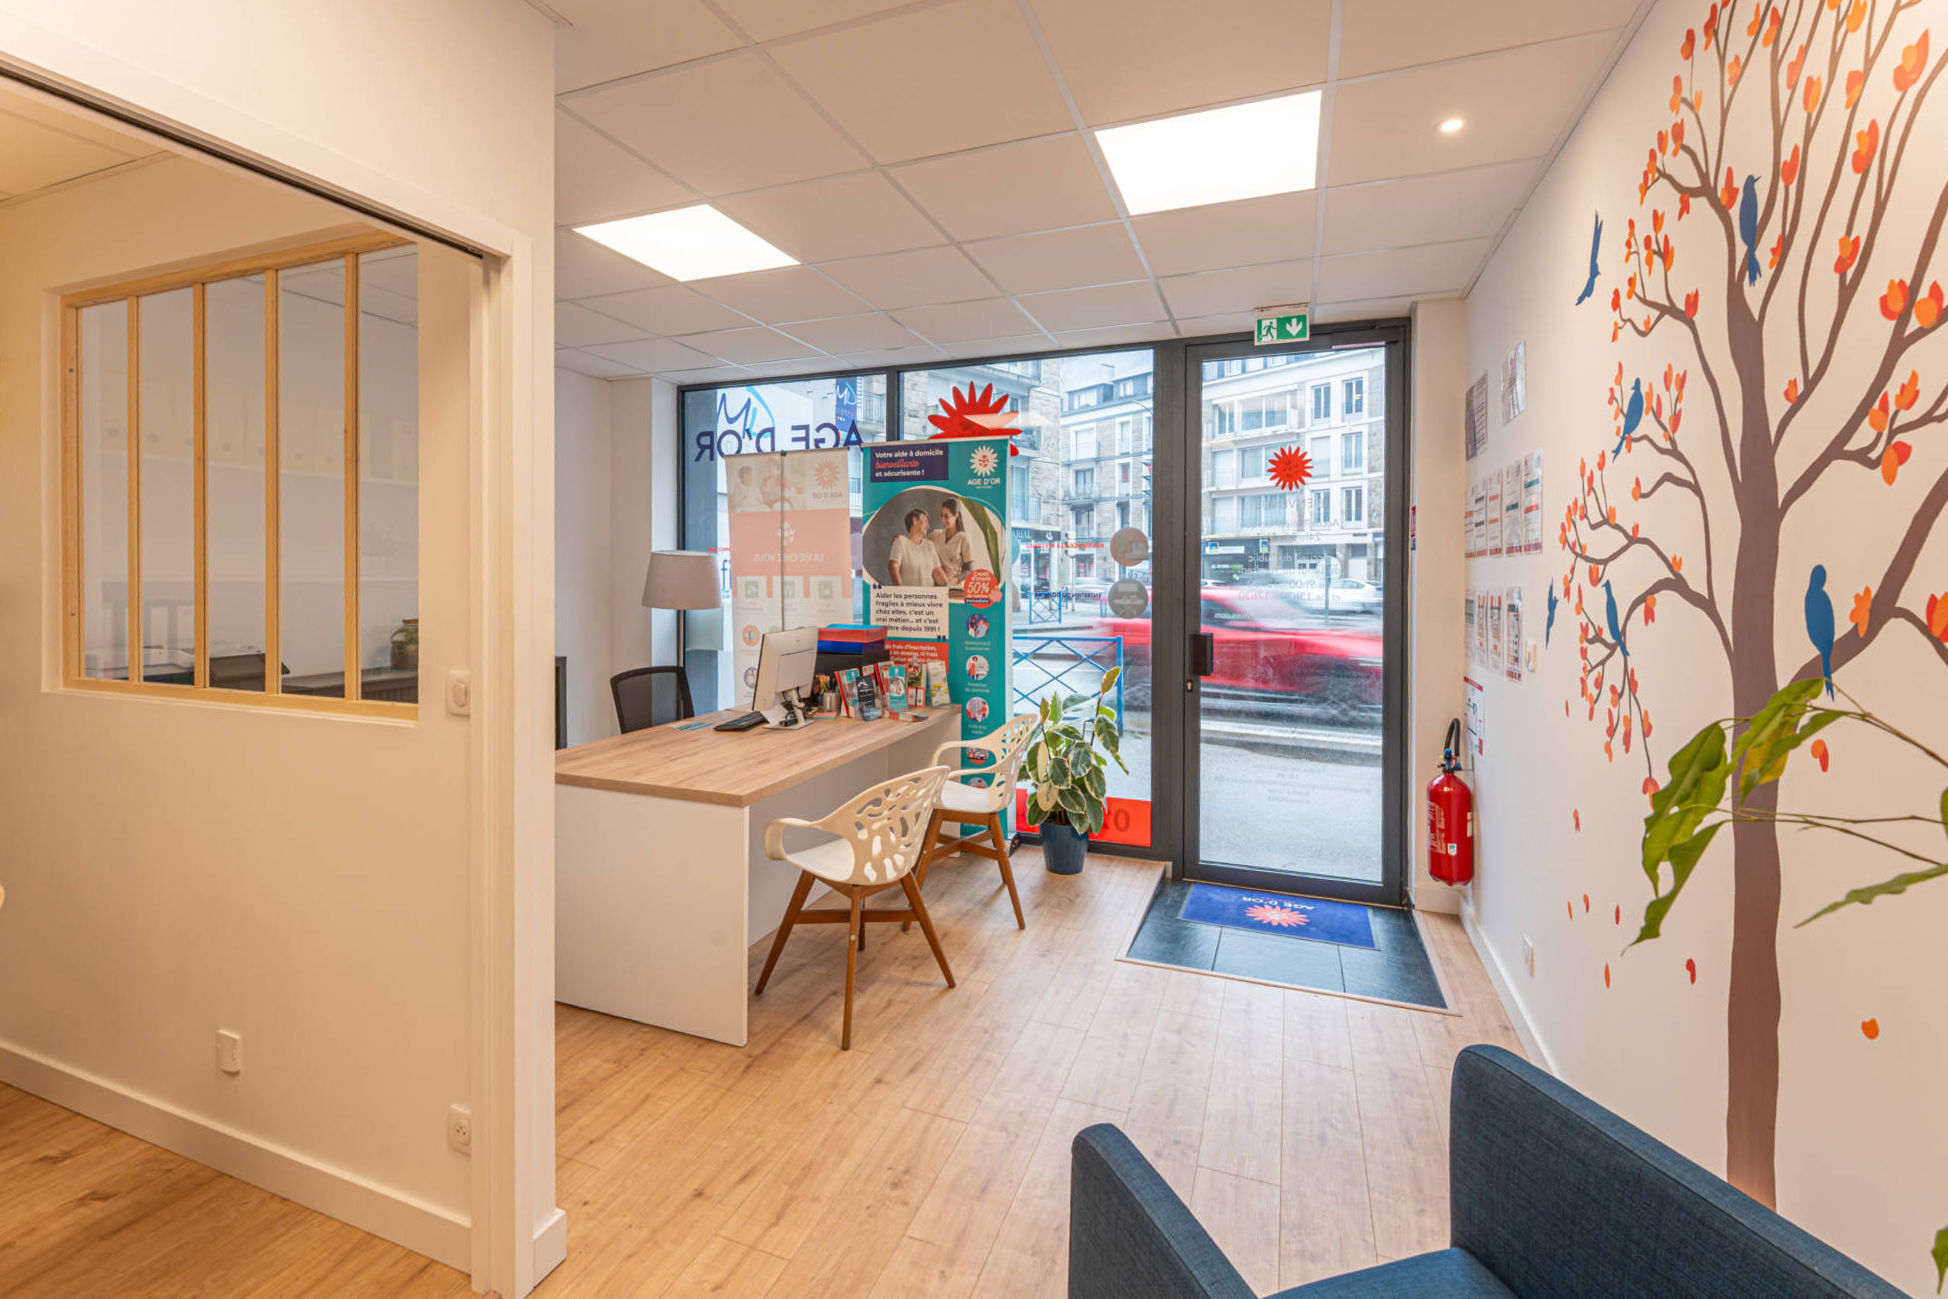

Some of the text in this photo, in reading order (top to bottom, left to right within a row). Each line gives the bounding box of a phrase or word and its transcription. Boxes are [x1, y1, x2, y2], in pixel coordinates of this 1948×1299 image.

[875, 451, 893, 459] Votre
[909, 448, 914, 457] à
[915, 448, 944, 457] domicile
[884, 469, 921, 478] sécurisante
[967, 477, 1000, 486] AGE D'OR
[967, 582, 990, 594] 50%
[901, 625, 922, 633] depuis
